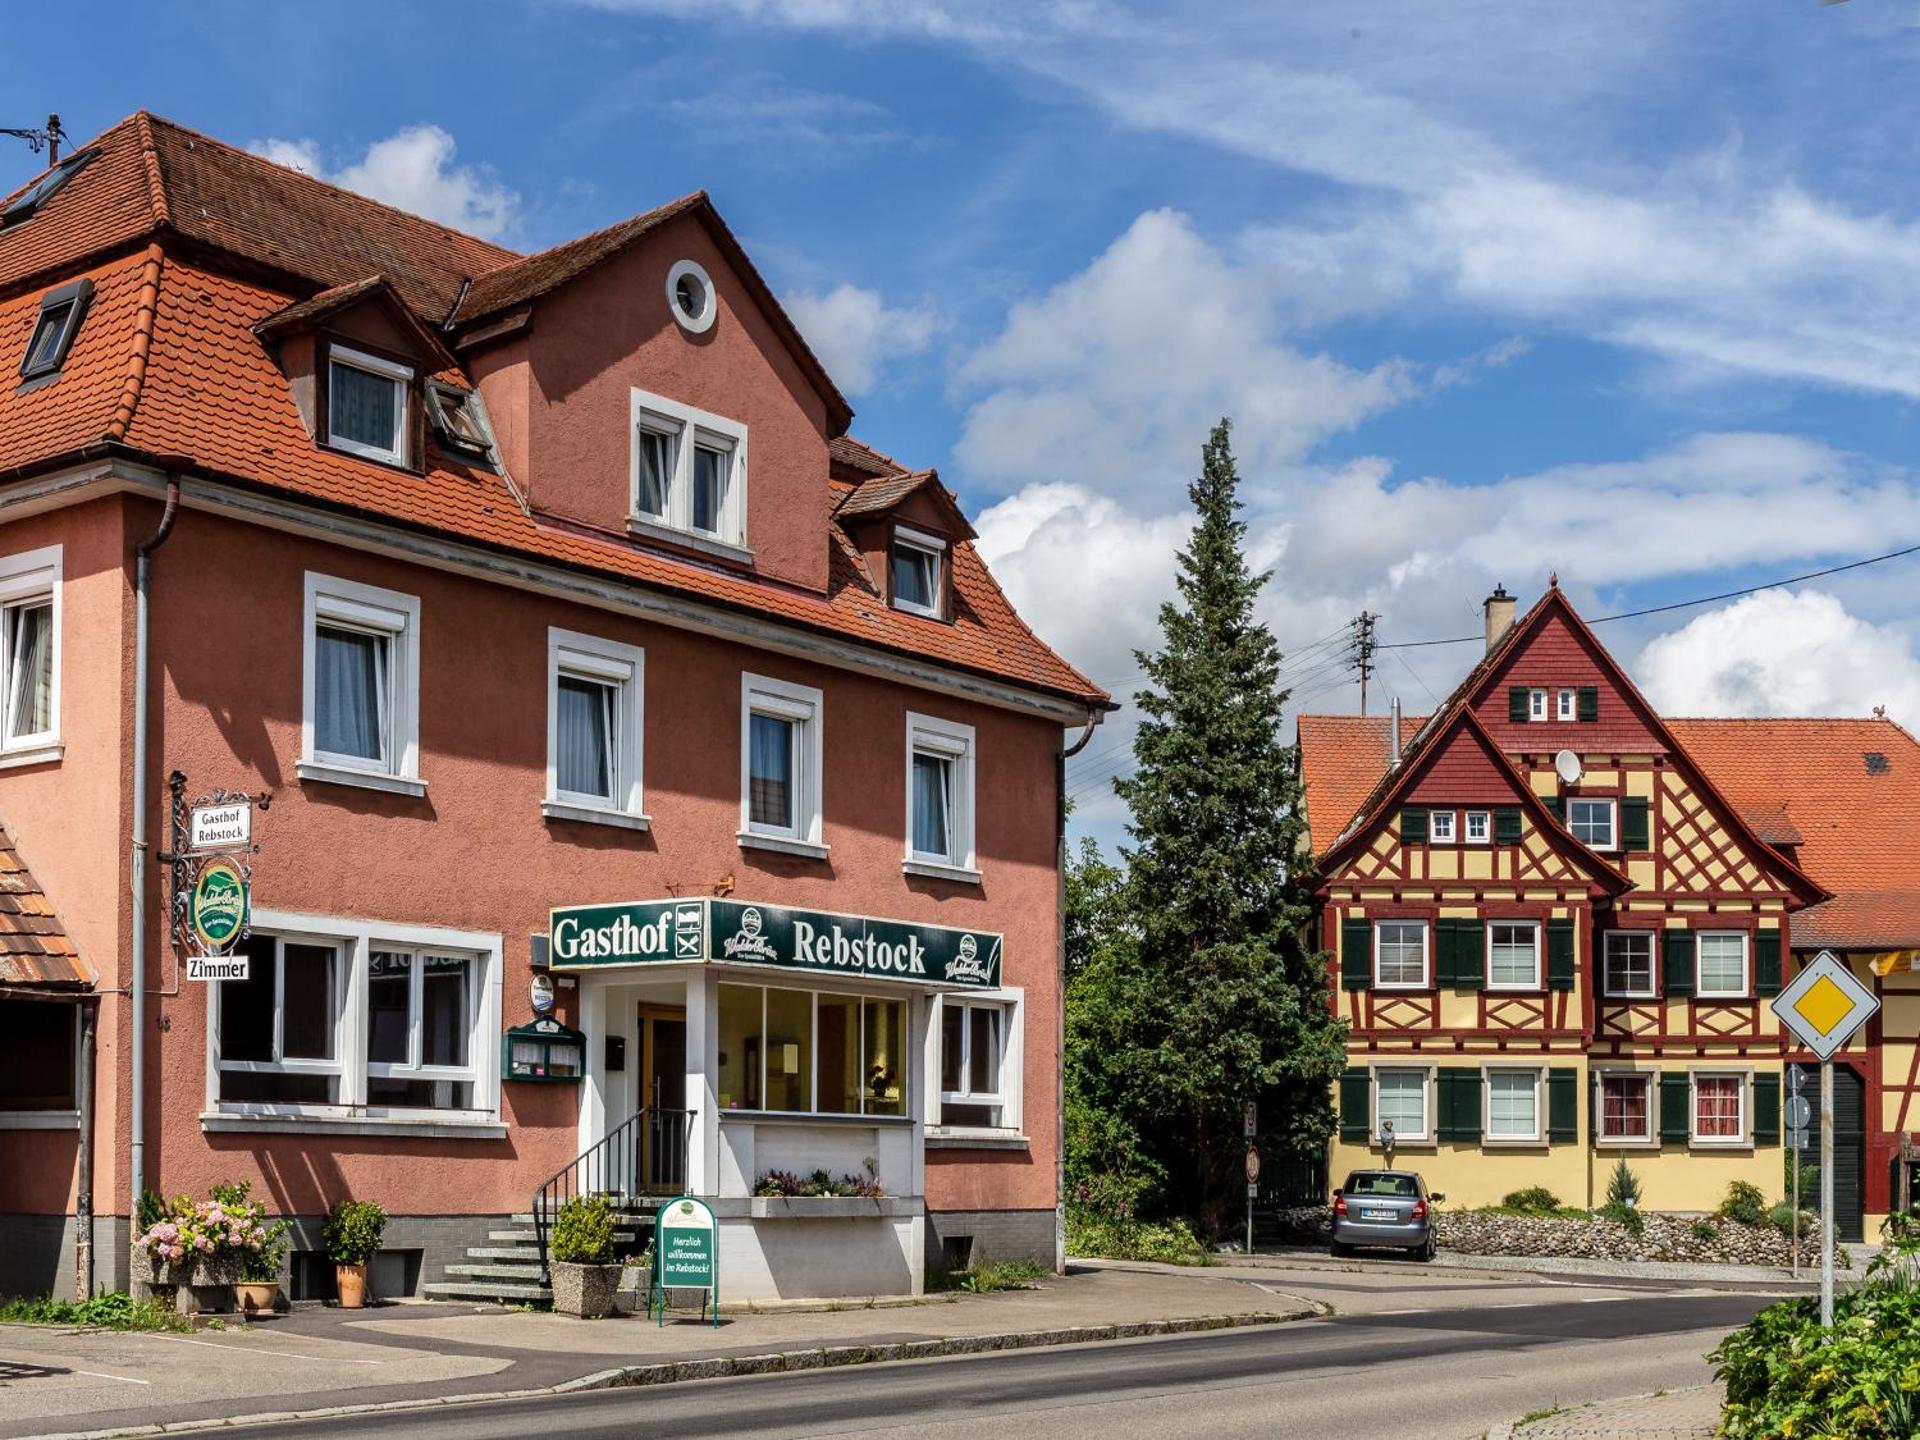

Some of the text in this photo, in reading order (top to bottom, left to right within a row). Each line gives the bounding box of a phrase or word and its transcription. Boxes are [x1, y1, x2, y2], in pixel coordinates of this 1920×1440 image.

[202, 809, 240, 825] Gasthof
[199, 826, 243, 842] Rebstock
[553, 910, 673, 959] Gasthof
[792, 921, 925, 974] Rebstock
[190, 960, 246, 978] Zimmer
[672, 1236, 701, 1246] Herzlich
[667, 1249, 707, 1259] willkommen
[675, 1263, 710, 1273] Rebstock!
